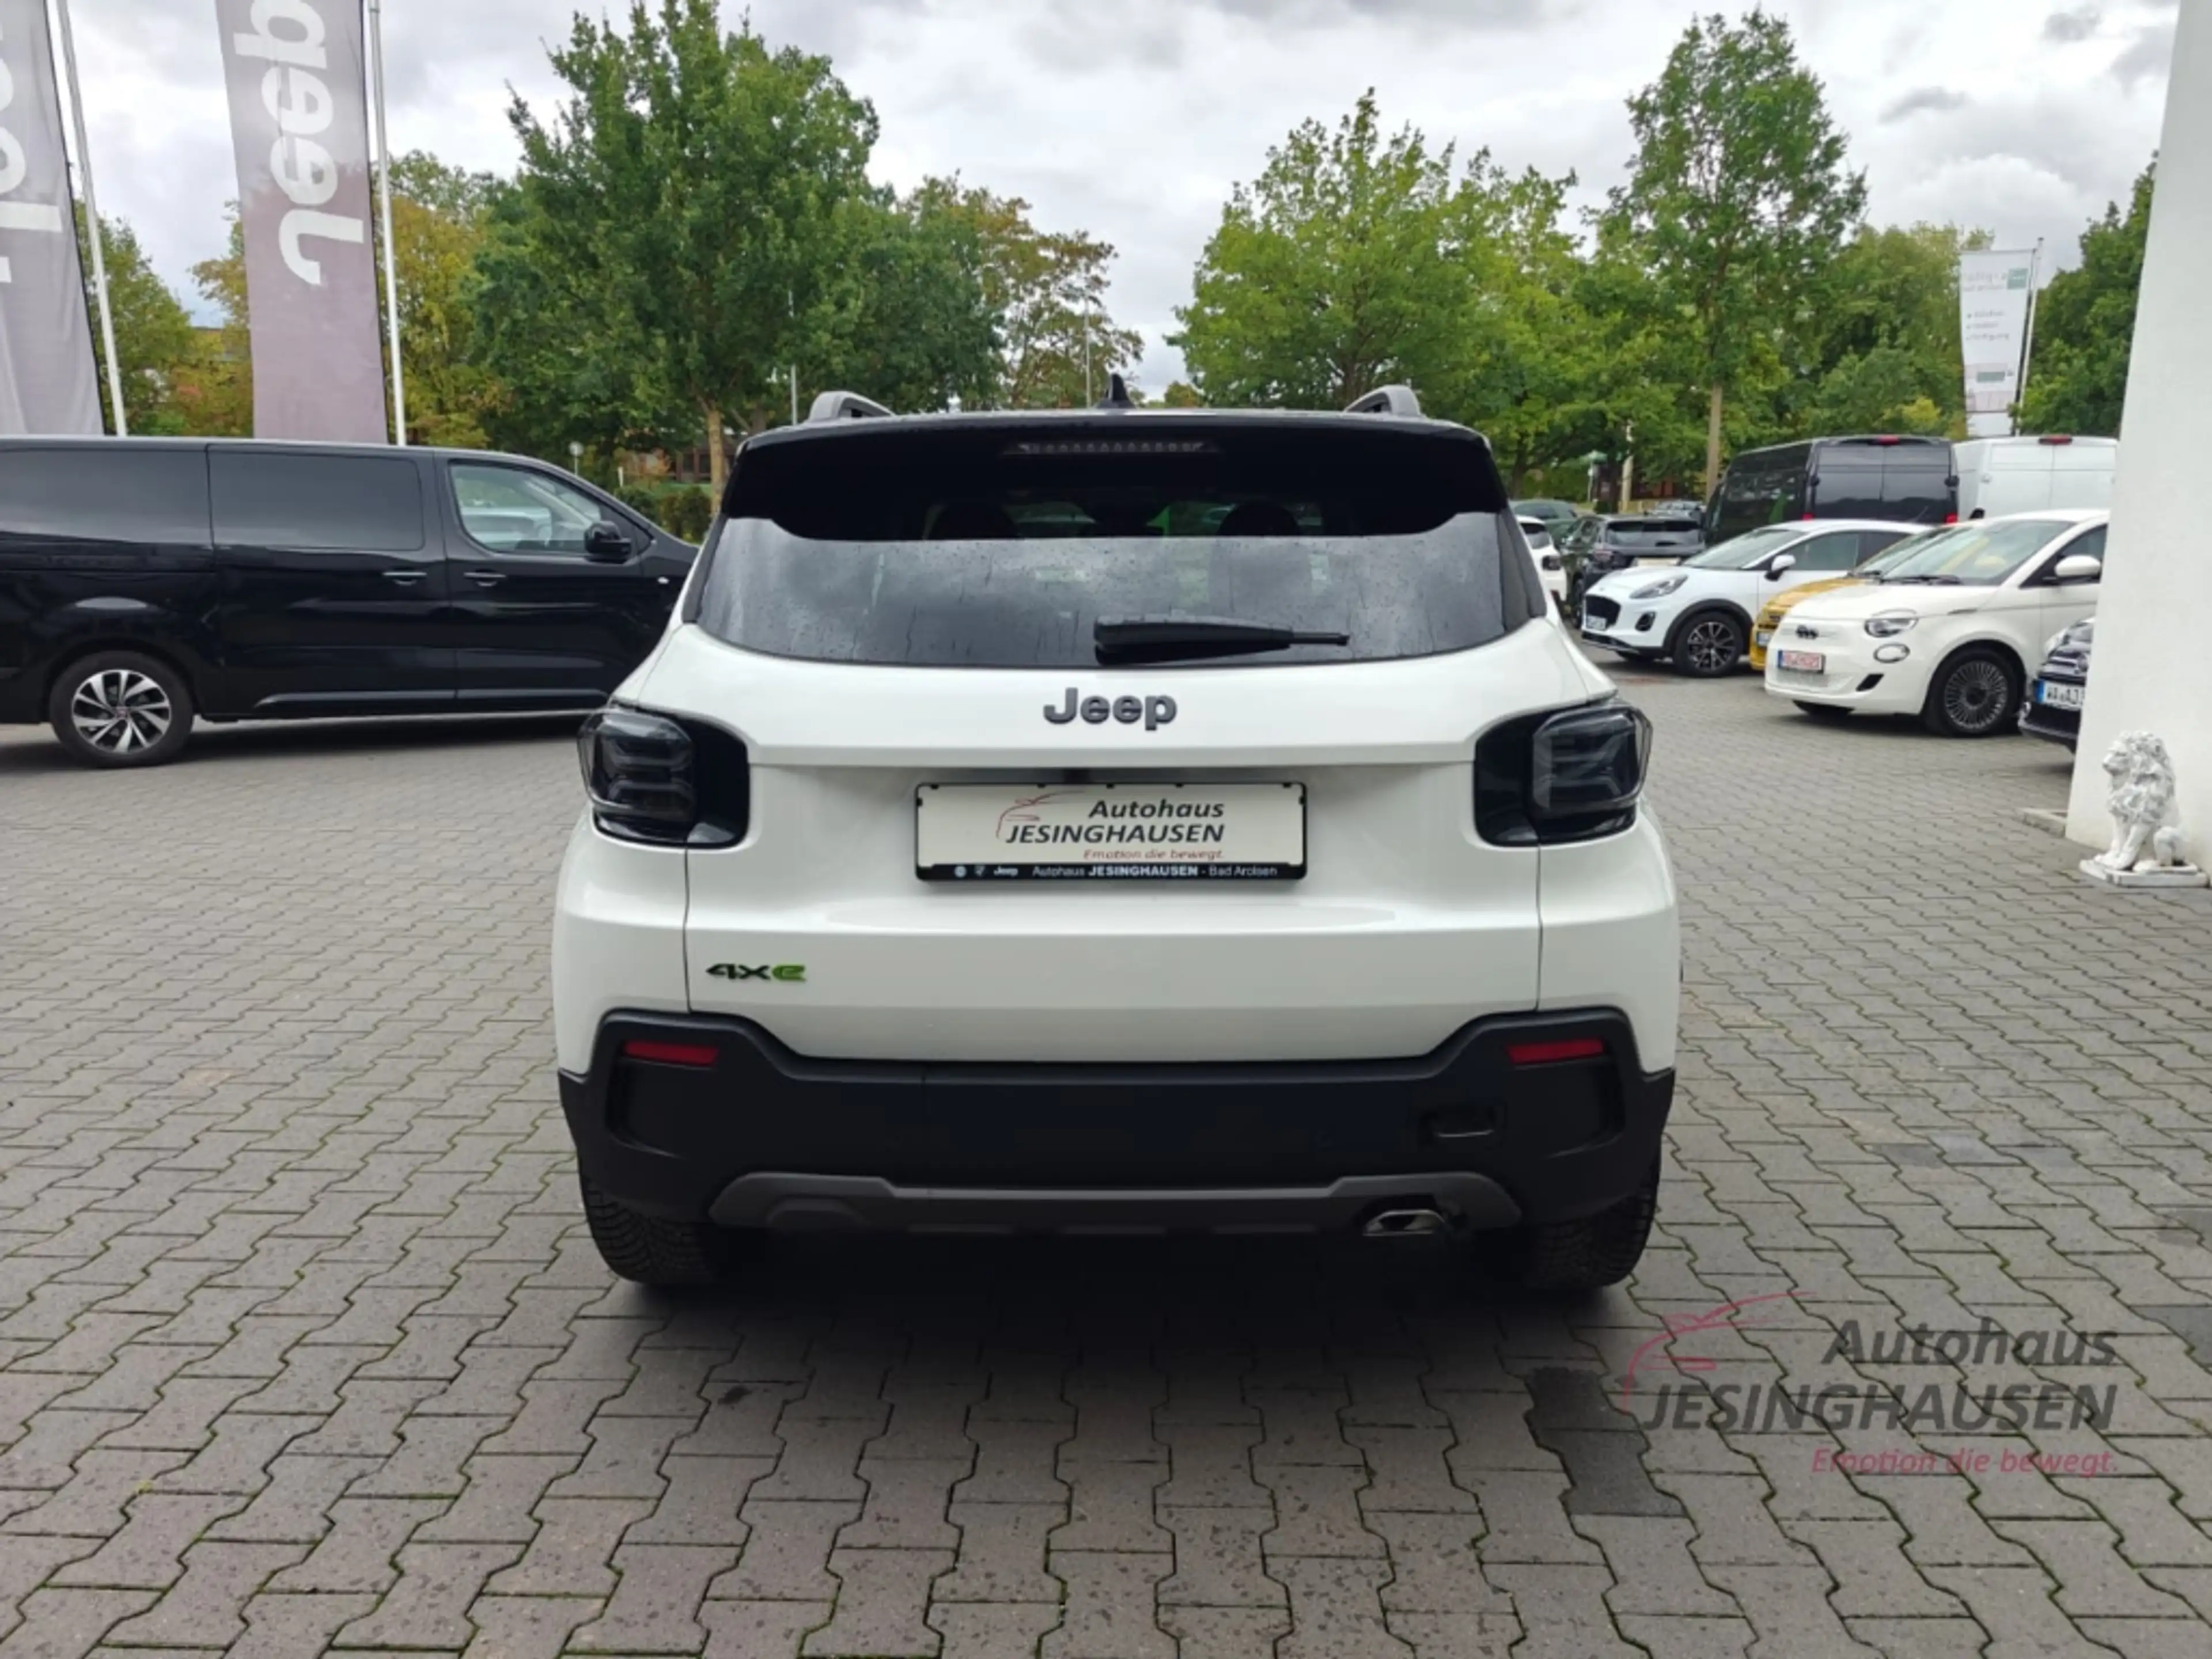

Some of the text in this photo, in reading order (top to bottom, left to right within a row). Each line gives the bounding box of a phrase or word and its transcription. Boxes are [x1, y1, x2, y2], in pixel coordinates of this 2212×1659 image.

[1043, 687, 1177, 731] Jeep
[1088, 798, 1224, 819] Autohaus
[1005, 824, 1225, 843] JESINGHAUSEN
[1084, 849, 1141, 860] Emotion
[1145, 849, 1166, 859] die
[993, 866, 1018, 877] Jeep
[1032, 866, 1085, 876] Autohaus
[1089, 866, 1198, 876] JESINGHAUSEN
[1210, 866, 1232, 876] Bad
